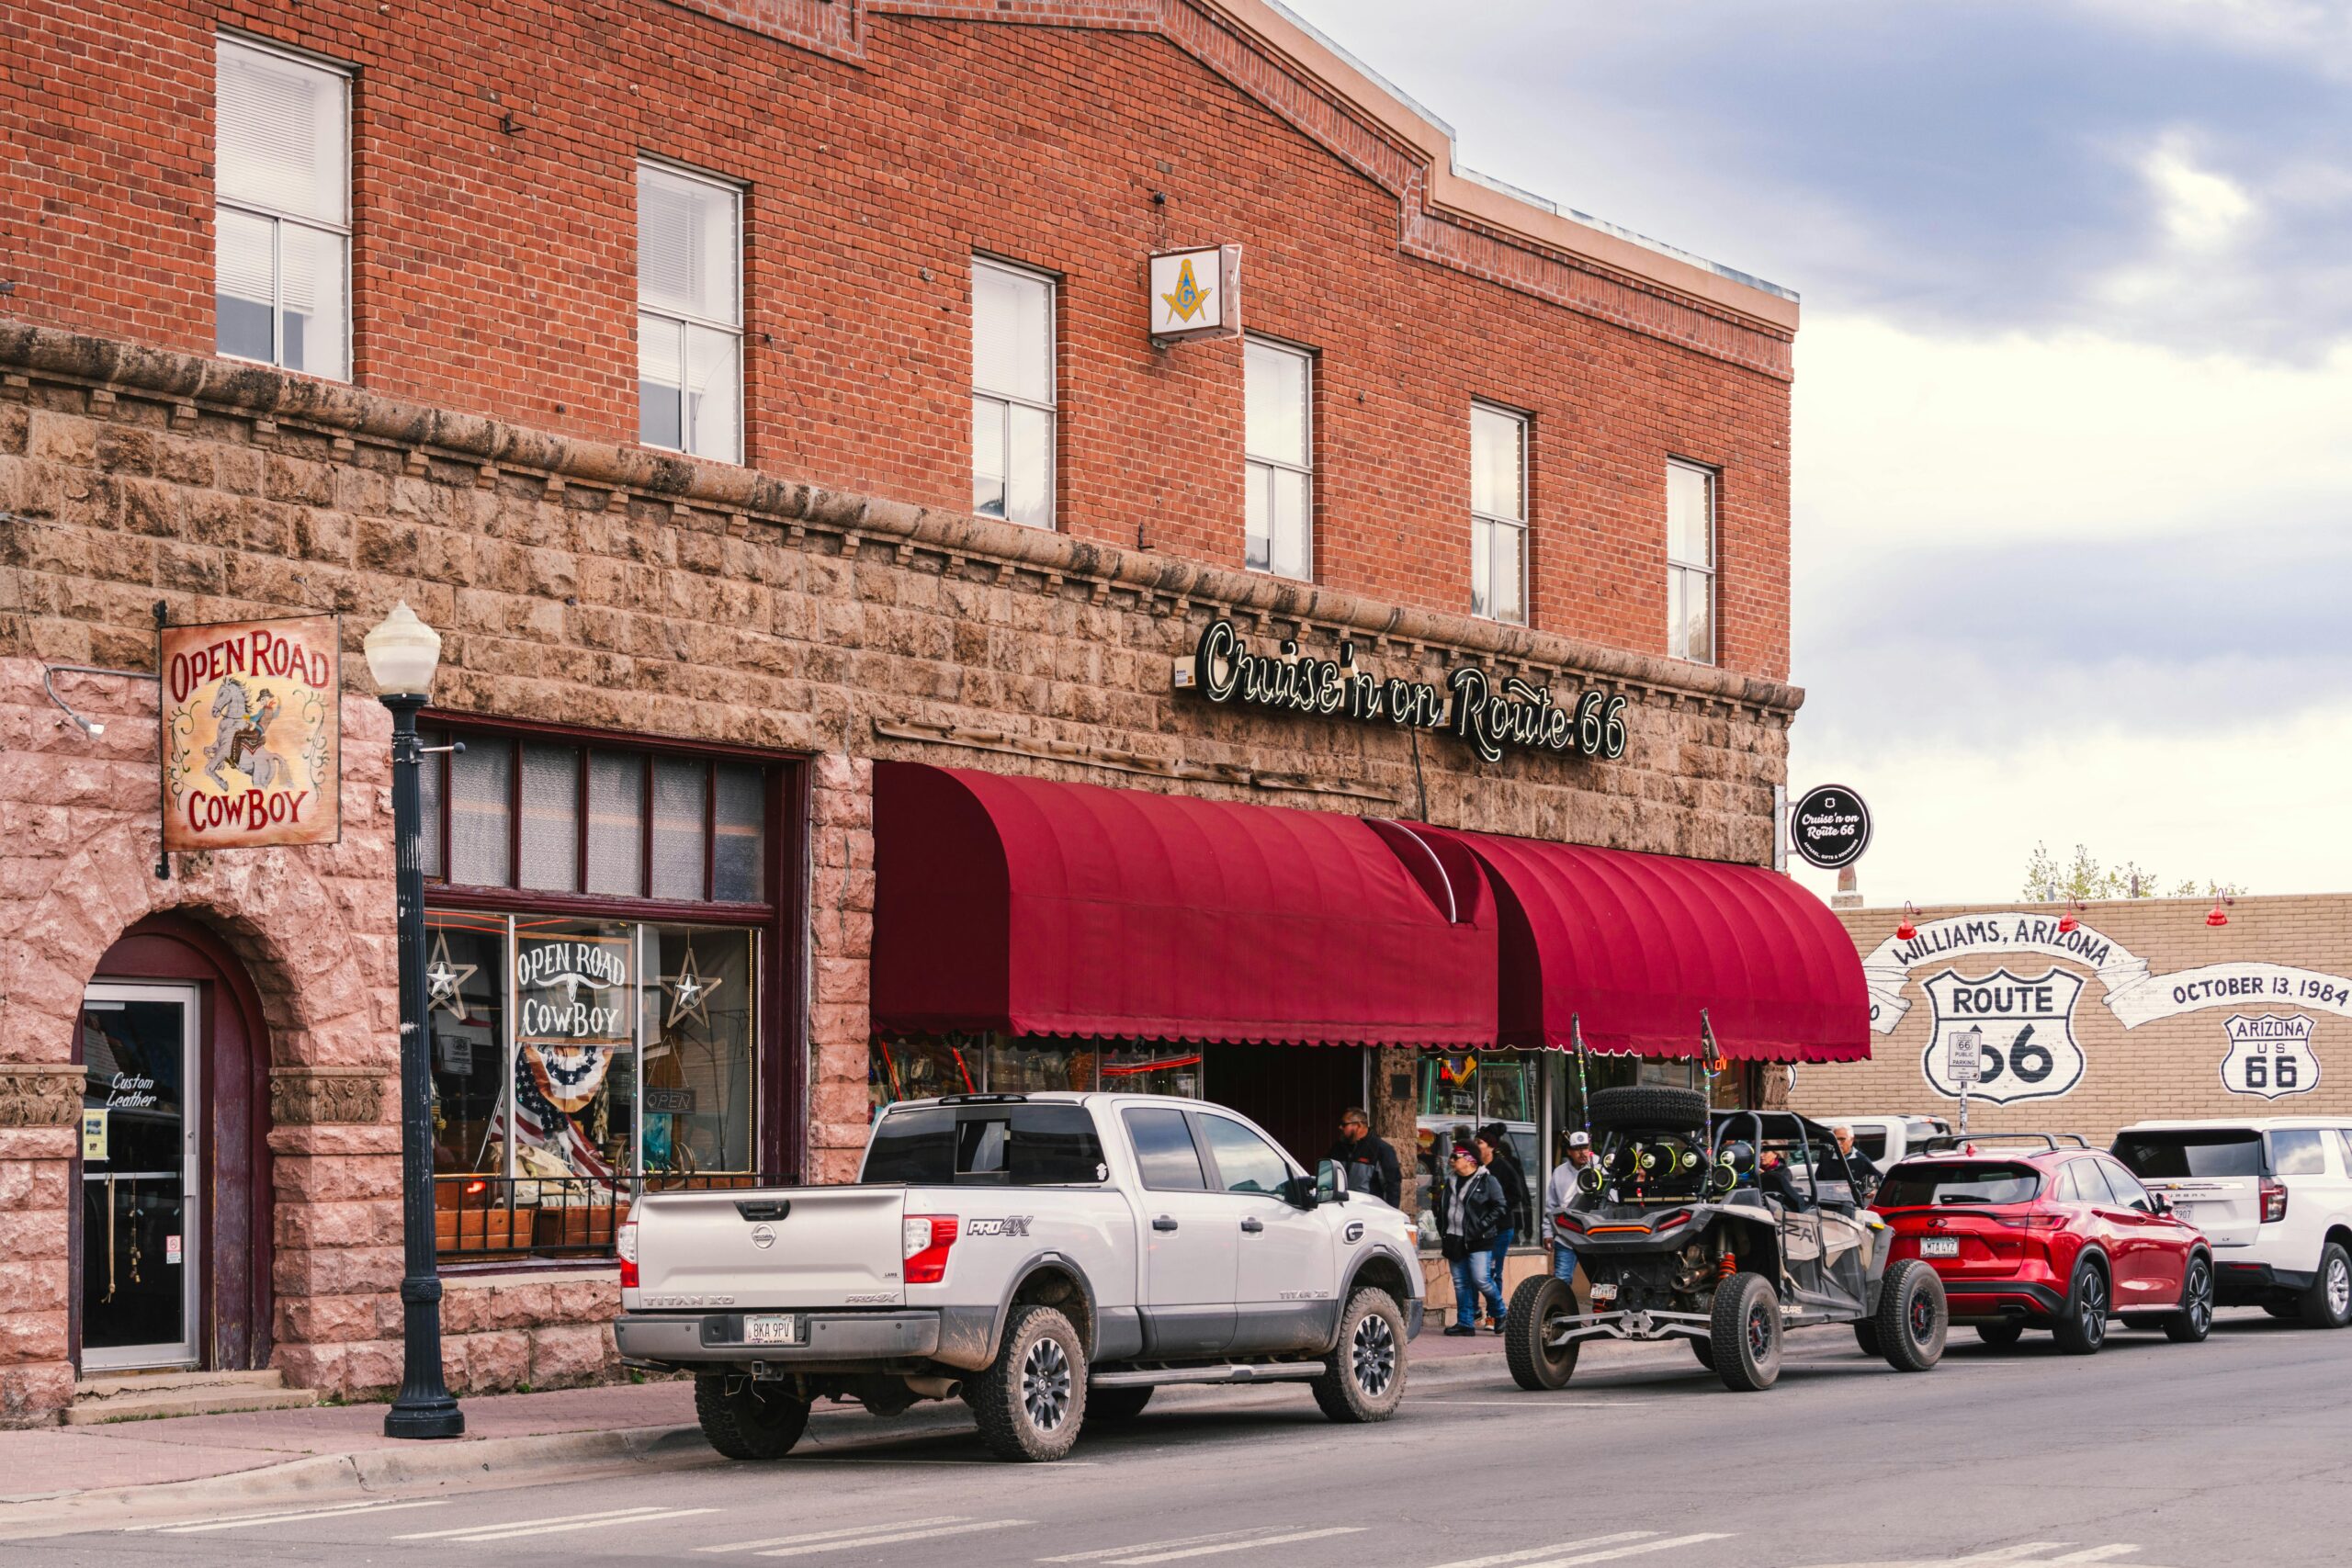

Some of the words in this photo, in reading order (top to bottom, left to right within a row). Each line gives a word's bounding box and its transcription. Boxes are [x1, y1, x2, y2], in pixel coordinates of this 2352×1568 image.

[170, 637, 246, 704] OPEN
[249, 629, 331, 690] ROAD
[1195, 619, 1381, 721] Cruise'n
[1382, 677, 1442, 728] on
[1447, 667, 1574, 763] Route
[1574, 690, 1627, 761] 66
[1802, 812, 1844, 824] Cruise'n
[1807, 825, 1839, 840] Route
[1840, 824, 1855, 836] 66
[1892, 919, 2009, 966] WILLIAMS,
[2014, 919, 2111, 967] ARIZONA
[517, 942, 571, 986] OPEN
[576, 942, 626, 987] ROAD
[1952, 986, 2053, 1013] ROUTE
[2173, 976, 2265, 1004] OCTOBER
[2272, 976, 2294, 998] 13,
[2299, 979, 2350, 1008] 1984
[2235, 1021, 2305, 1037] ARIZONA
[1958, 1041, 1971, 1049] 66
[112, 1071, 154, 1089] Custom
[2245, 1055, 2297, 1089] 66
[106, 1089, 157, 1108] Leather
[647, 1094, 691, 1110] OPEN
[643, 1294, 705, 1306] TITAN
[708, 1294, 735, 1305] XD
[1278, 1290, 1312, 1300] TITAN
[753, 1323, 771, 1337] 8KA
[773, 1323, 790, 1337] 9PV
